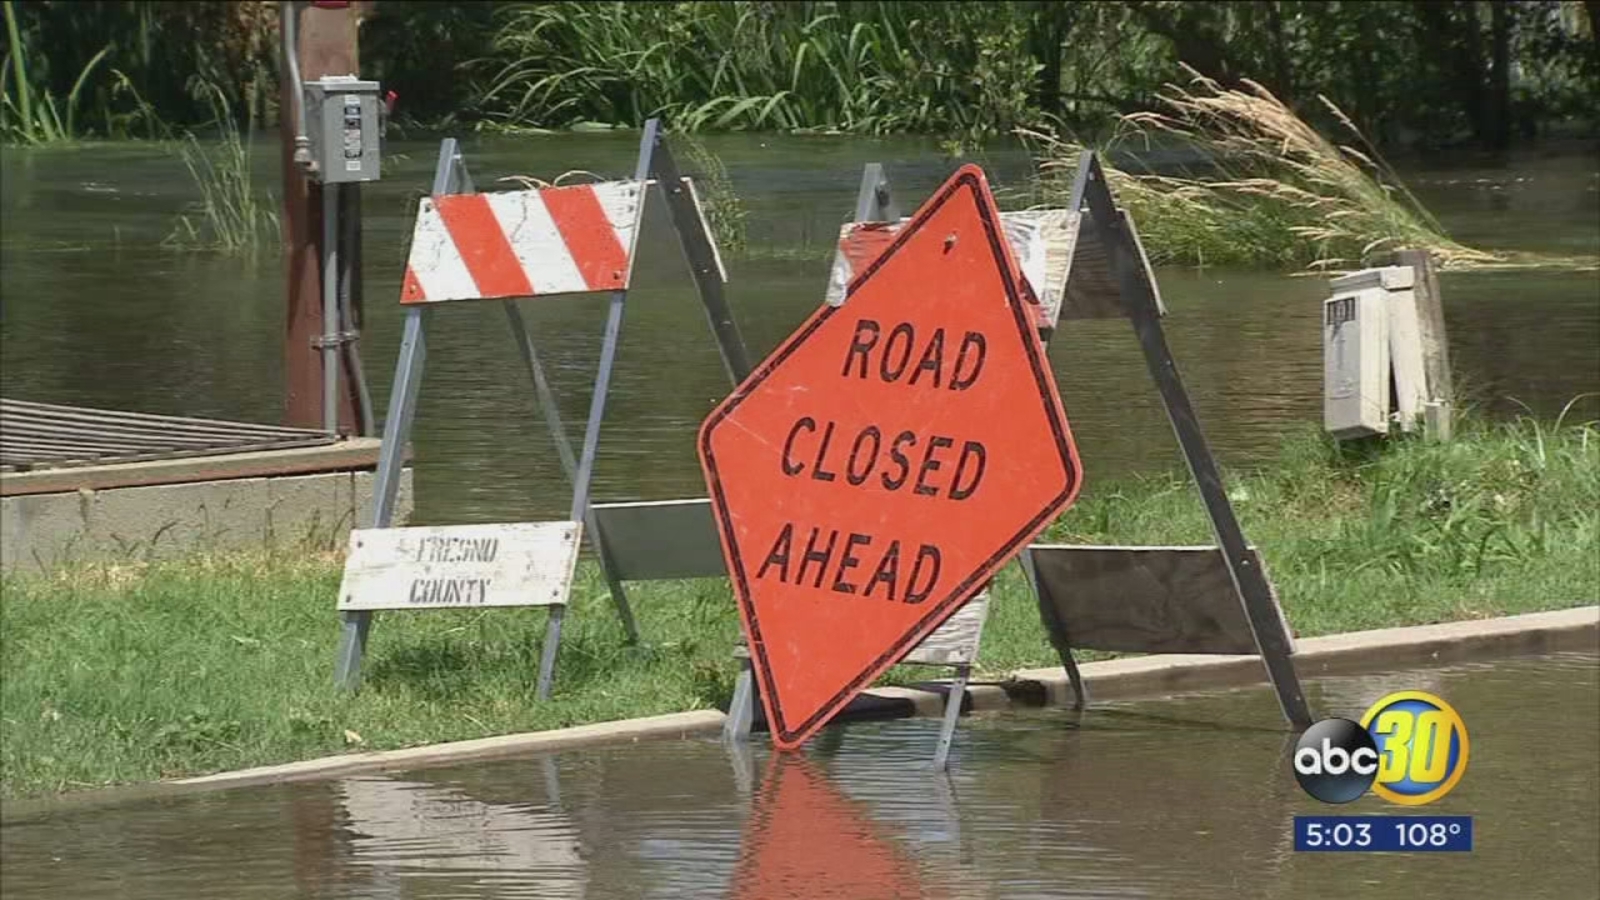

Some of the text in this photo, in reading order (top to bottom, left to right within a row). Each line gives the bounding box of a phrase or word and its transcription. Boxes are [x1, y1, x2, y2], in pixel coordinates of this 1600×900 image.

[842, 319, 987, 391] ROAD
[781, 416, 987, 501] CLOSED
[416, 537, 499, 562] FRESNO
[756, 522, 942, 604] AHEAD
[409, 579, 491, 603] COUNTY
